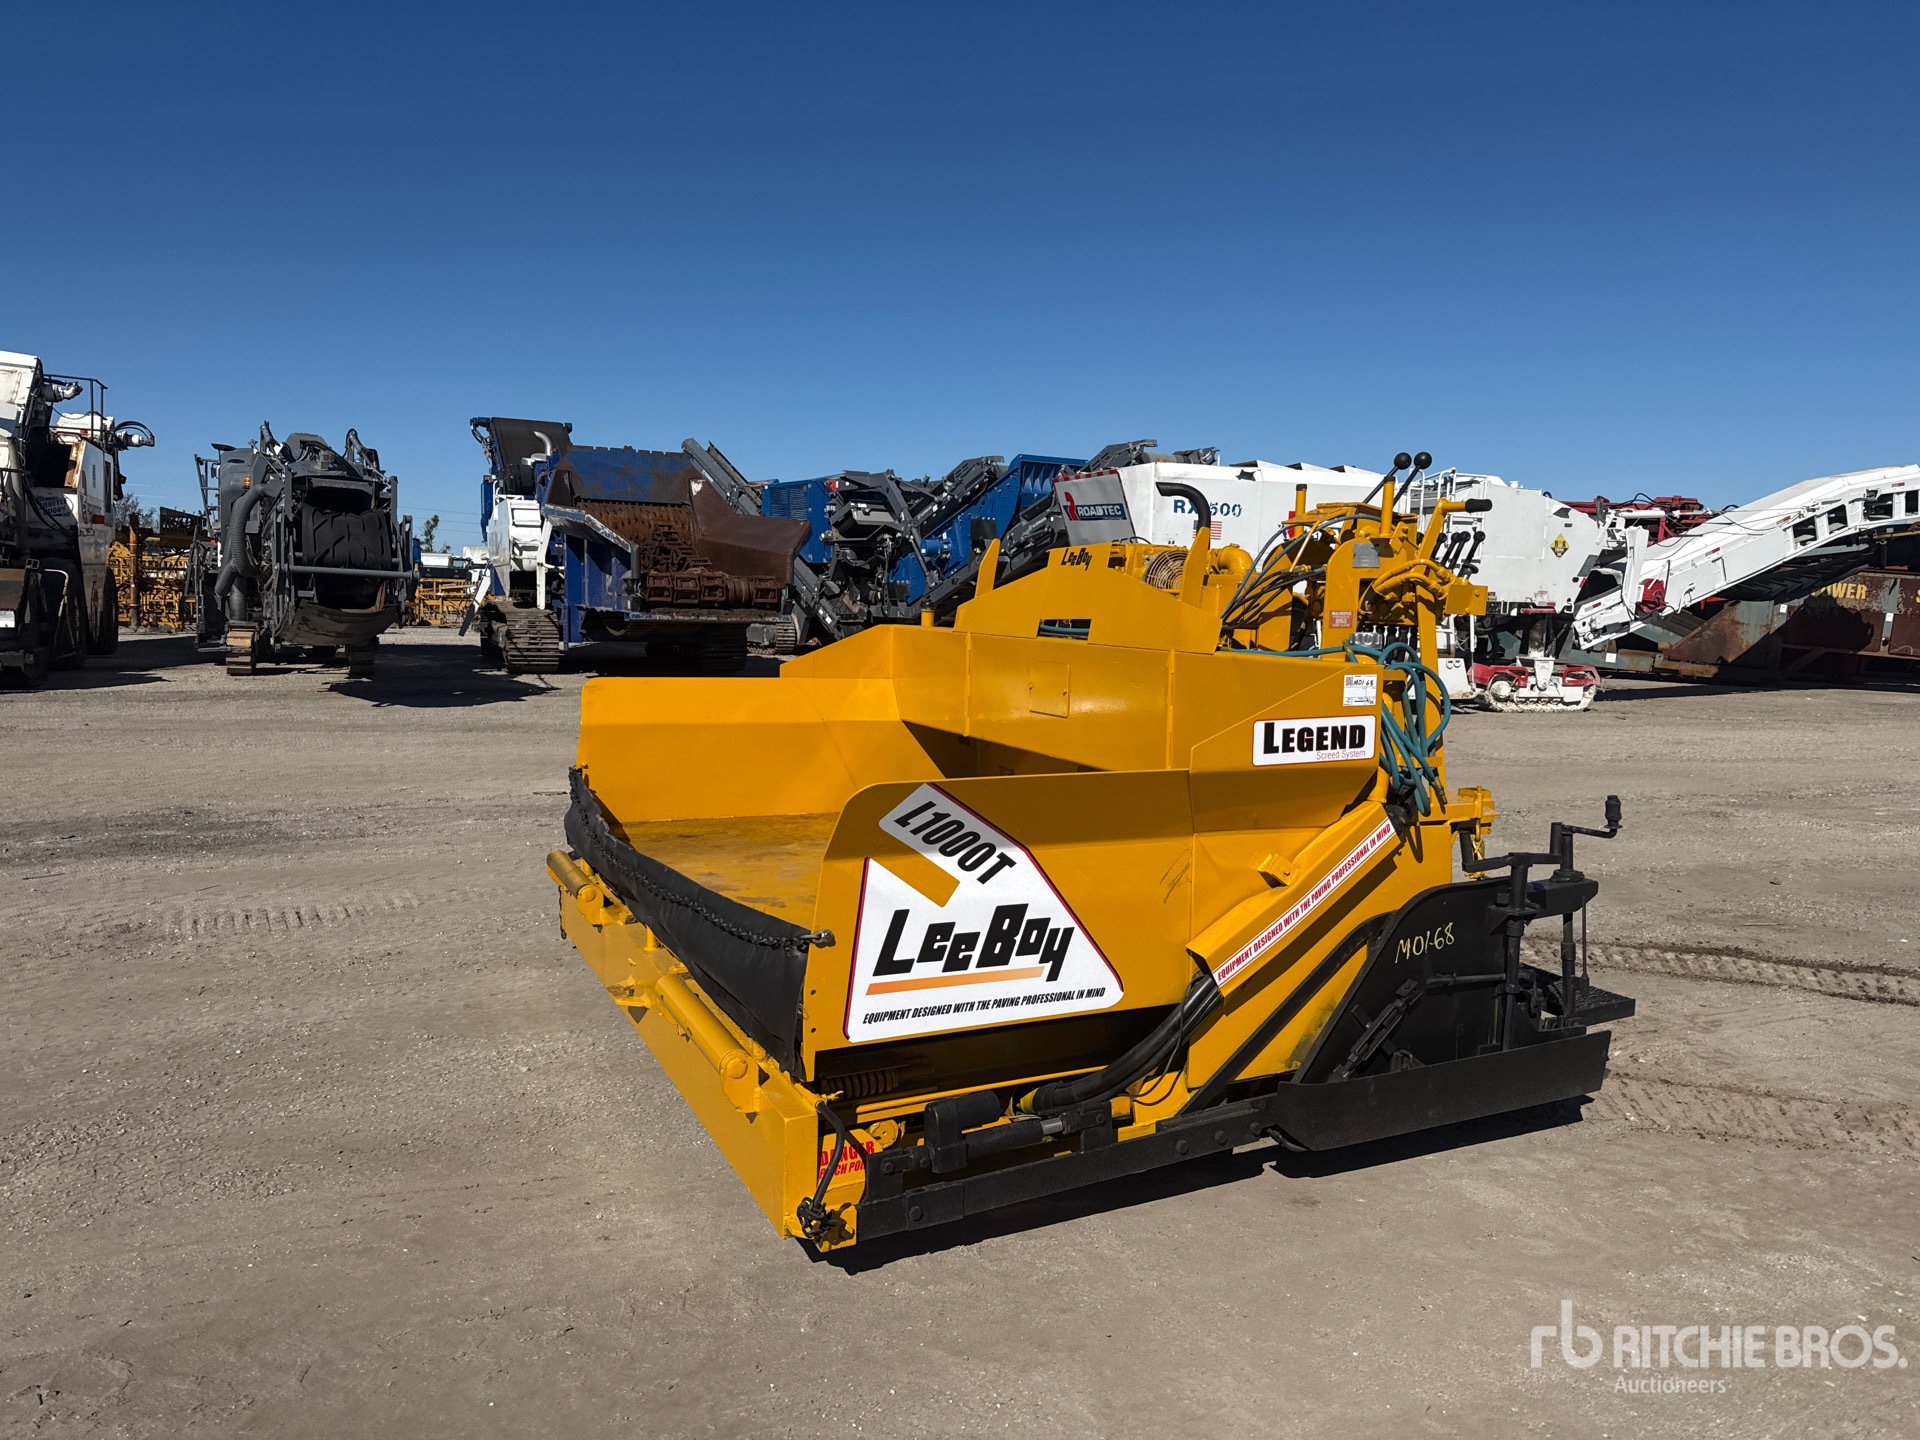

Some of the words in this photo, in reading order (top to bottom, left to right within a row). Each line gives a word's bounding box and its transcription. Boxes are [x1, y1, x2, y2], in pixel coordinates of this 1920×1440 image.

[1077, 505, 1122, 516] ROADTEC
[1316, 751, 1340, 760] Screed
[1341, 749, 1366, 760] System
[893, 800, 1017, 885] L1000T
[1217, 946, 1254, 982] EQUIPMENT
[1252, 924, 1284, 953] DESIGNED
[1283, 909, 1300, 930] WITH
[1299, 898, 1312, 914] THE
[1311, 878, 1332, 905] PAVING
[1330, 846, 1371, 887] PROFESSIONAL
[1369, 836, 1378, 849] IN
[1376, 822, 1393, 843] MIND
[862, 1006, 913, 1024] EQUIPMENT
[911, 1003, 953, 1018] DESIGNED
[952, 999, 977, 1013] WITH
[975, 997, 991, 1010] THE
[990, 994, 1021, 1009] PAVING
[1020, 988, 1076, 1006] PROFESSIONAL
[1075, 987, 1085, 999] IN
[1084, 986, 1107, 998] MIND
[820, 1140, 875, 1167] DNGR
